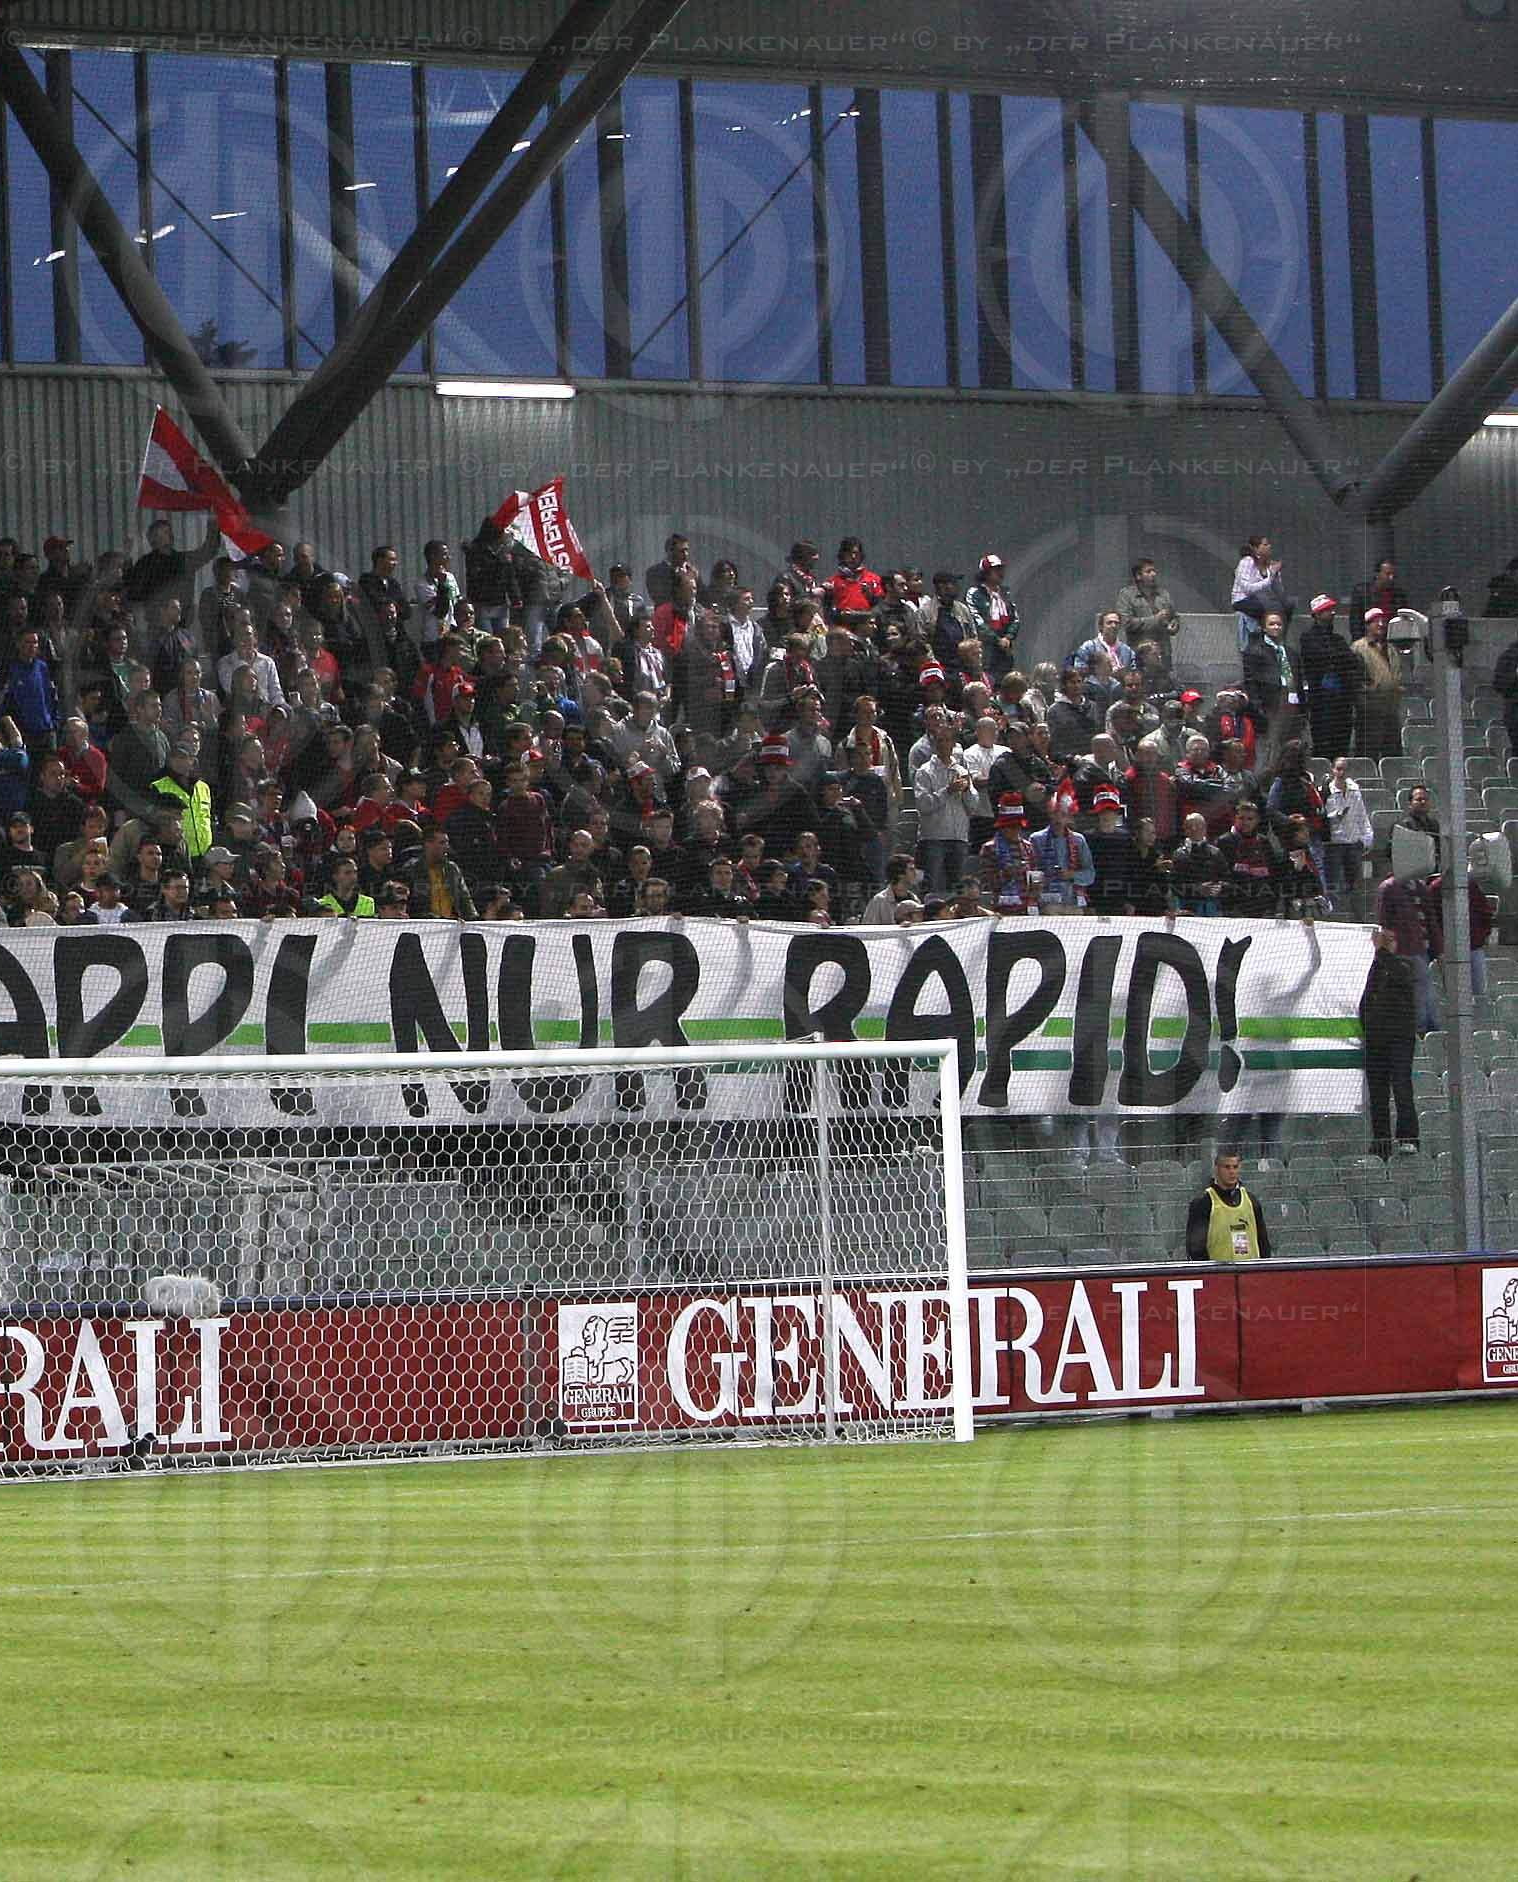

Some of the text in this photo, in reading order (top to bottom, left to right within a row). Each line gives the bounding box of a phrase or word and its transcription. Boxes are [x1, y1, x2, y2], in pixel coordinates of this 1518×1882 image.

[389, 931, 708, 1118] NUR
[783, 930, 1252, 1114] RAPID!
[563, 1384, 634, 1406] GENERALI
[666, 1279, 1205, 1422] GENERALI
